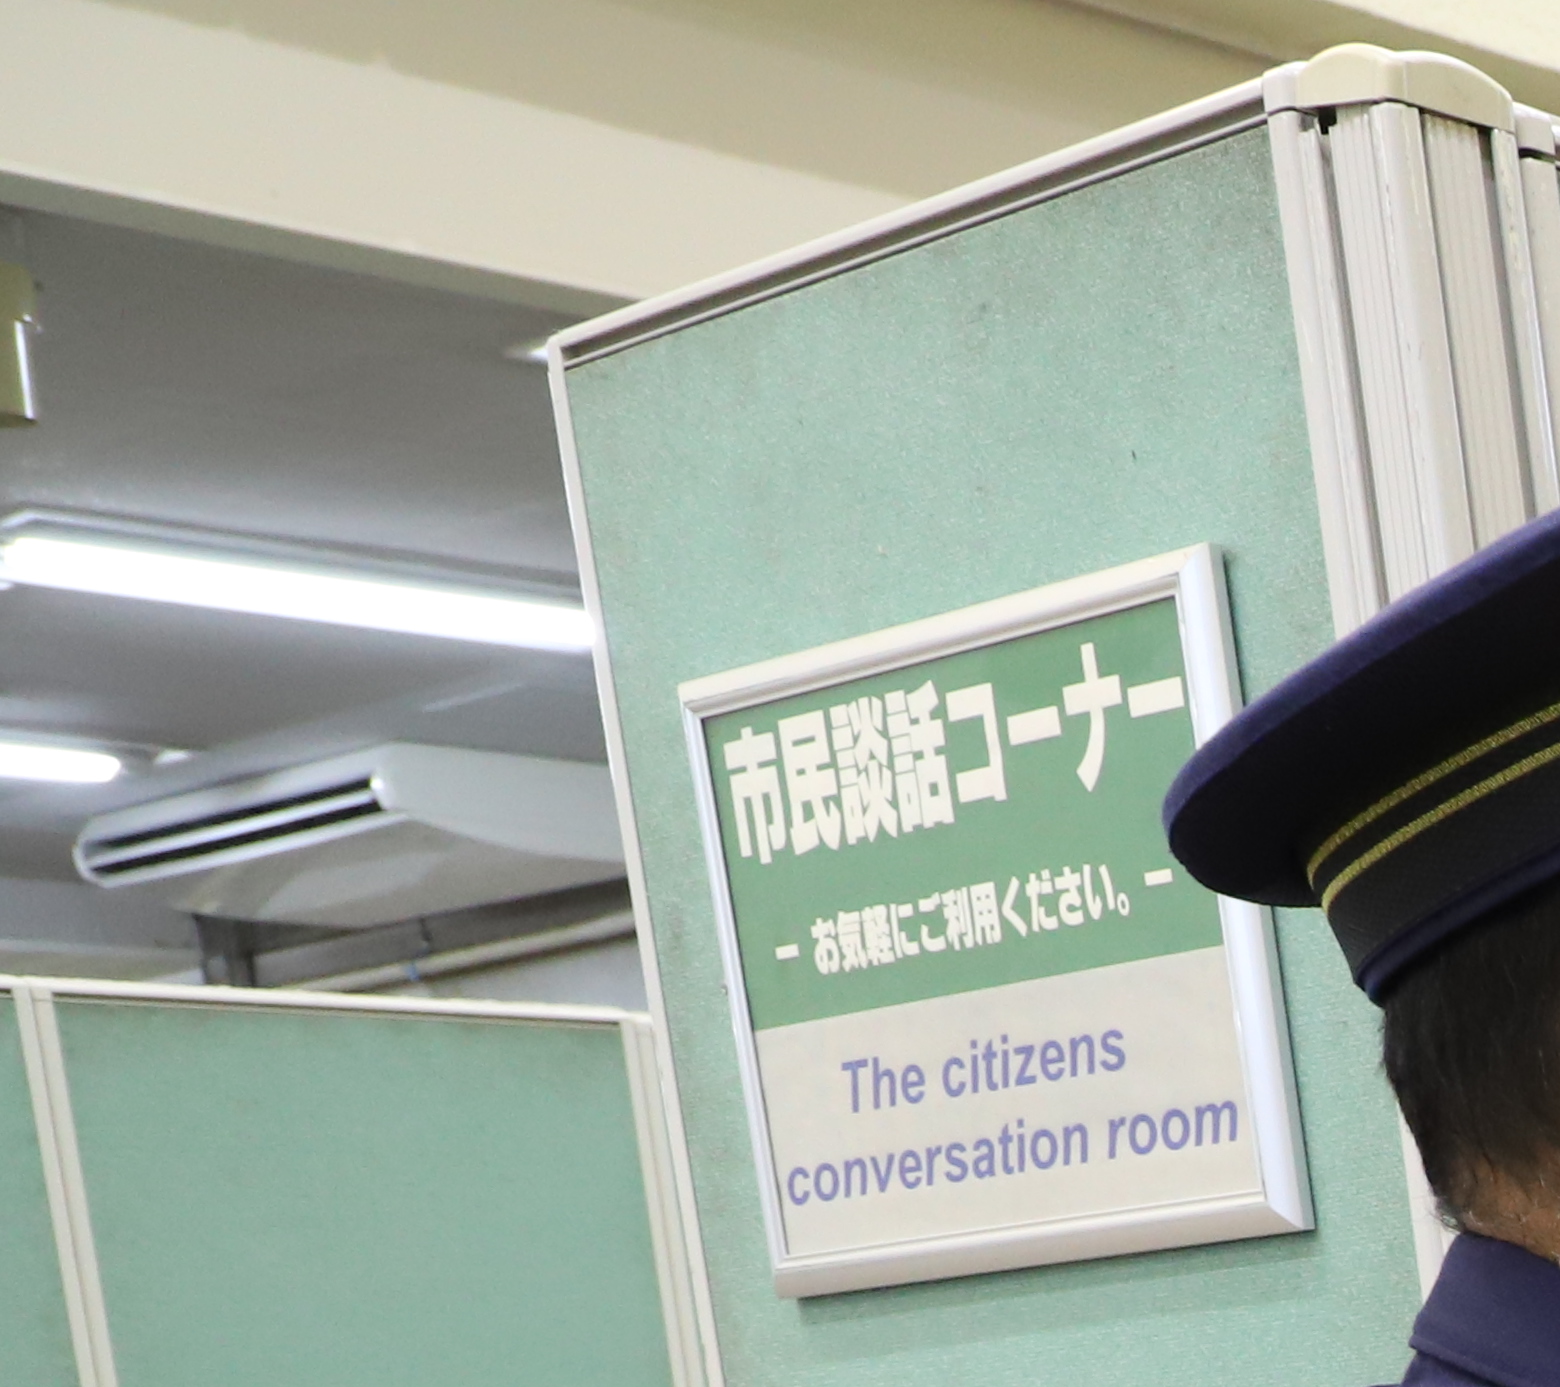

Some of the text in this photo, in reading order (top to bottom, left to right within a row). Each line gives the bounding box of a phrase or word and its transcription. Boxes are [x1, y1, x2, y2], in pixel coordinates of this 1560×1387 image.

[722, 641, 1187, 866] 市民談話コーナー
[840, 1027, 1127, 1116] The citizens
[786, 1097, 1240, 1207] conversation room
